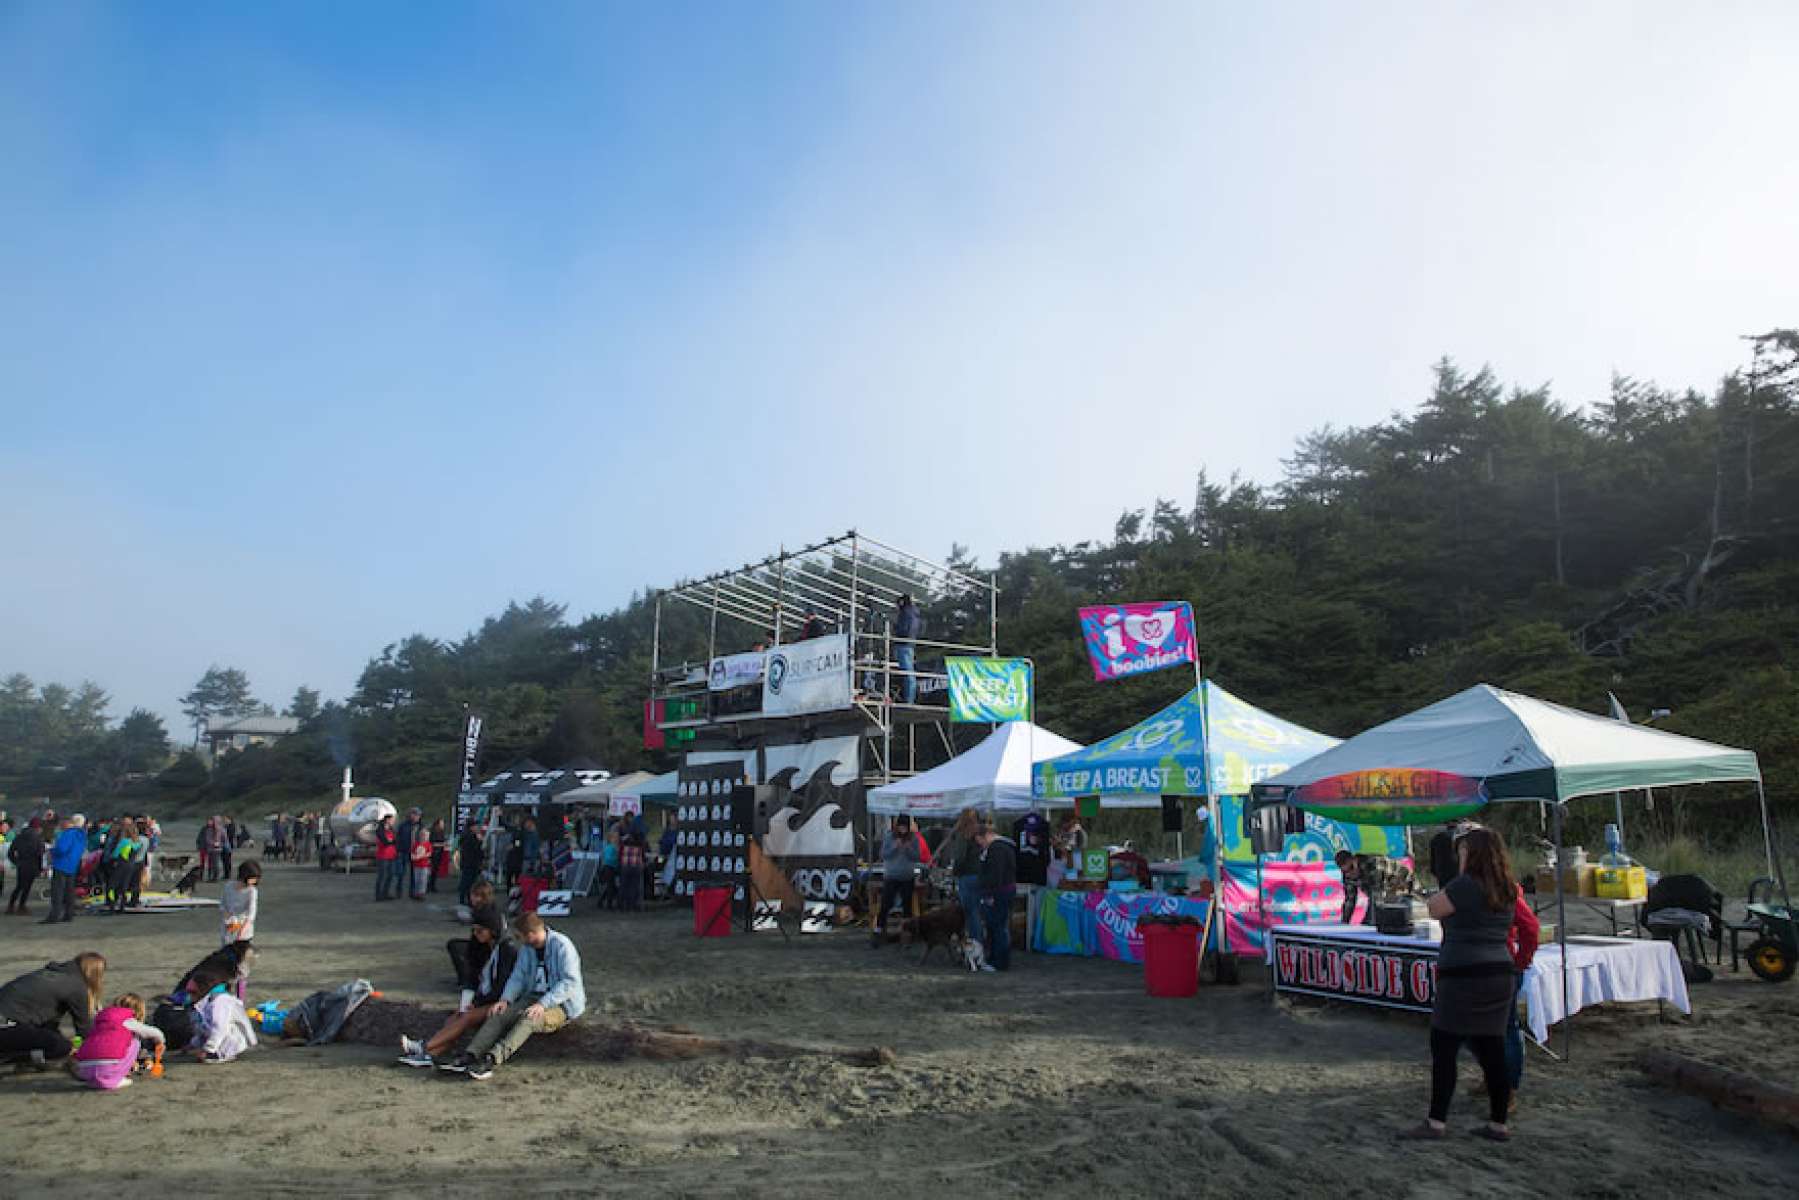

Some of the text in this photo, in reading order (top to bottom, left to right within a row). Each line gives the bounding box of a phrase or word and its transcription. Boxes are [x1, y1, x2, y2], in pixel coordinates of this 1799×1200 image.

[1053, 766, 1171, 792] KEEP A BREAST
